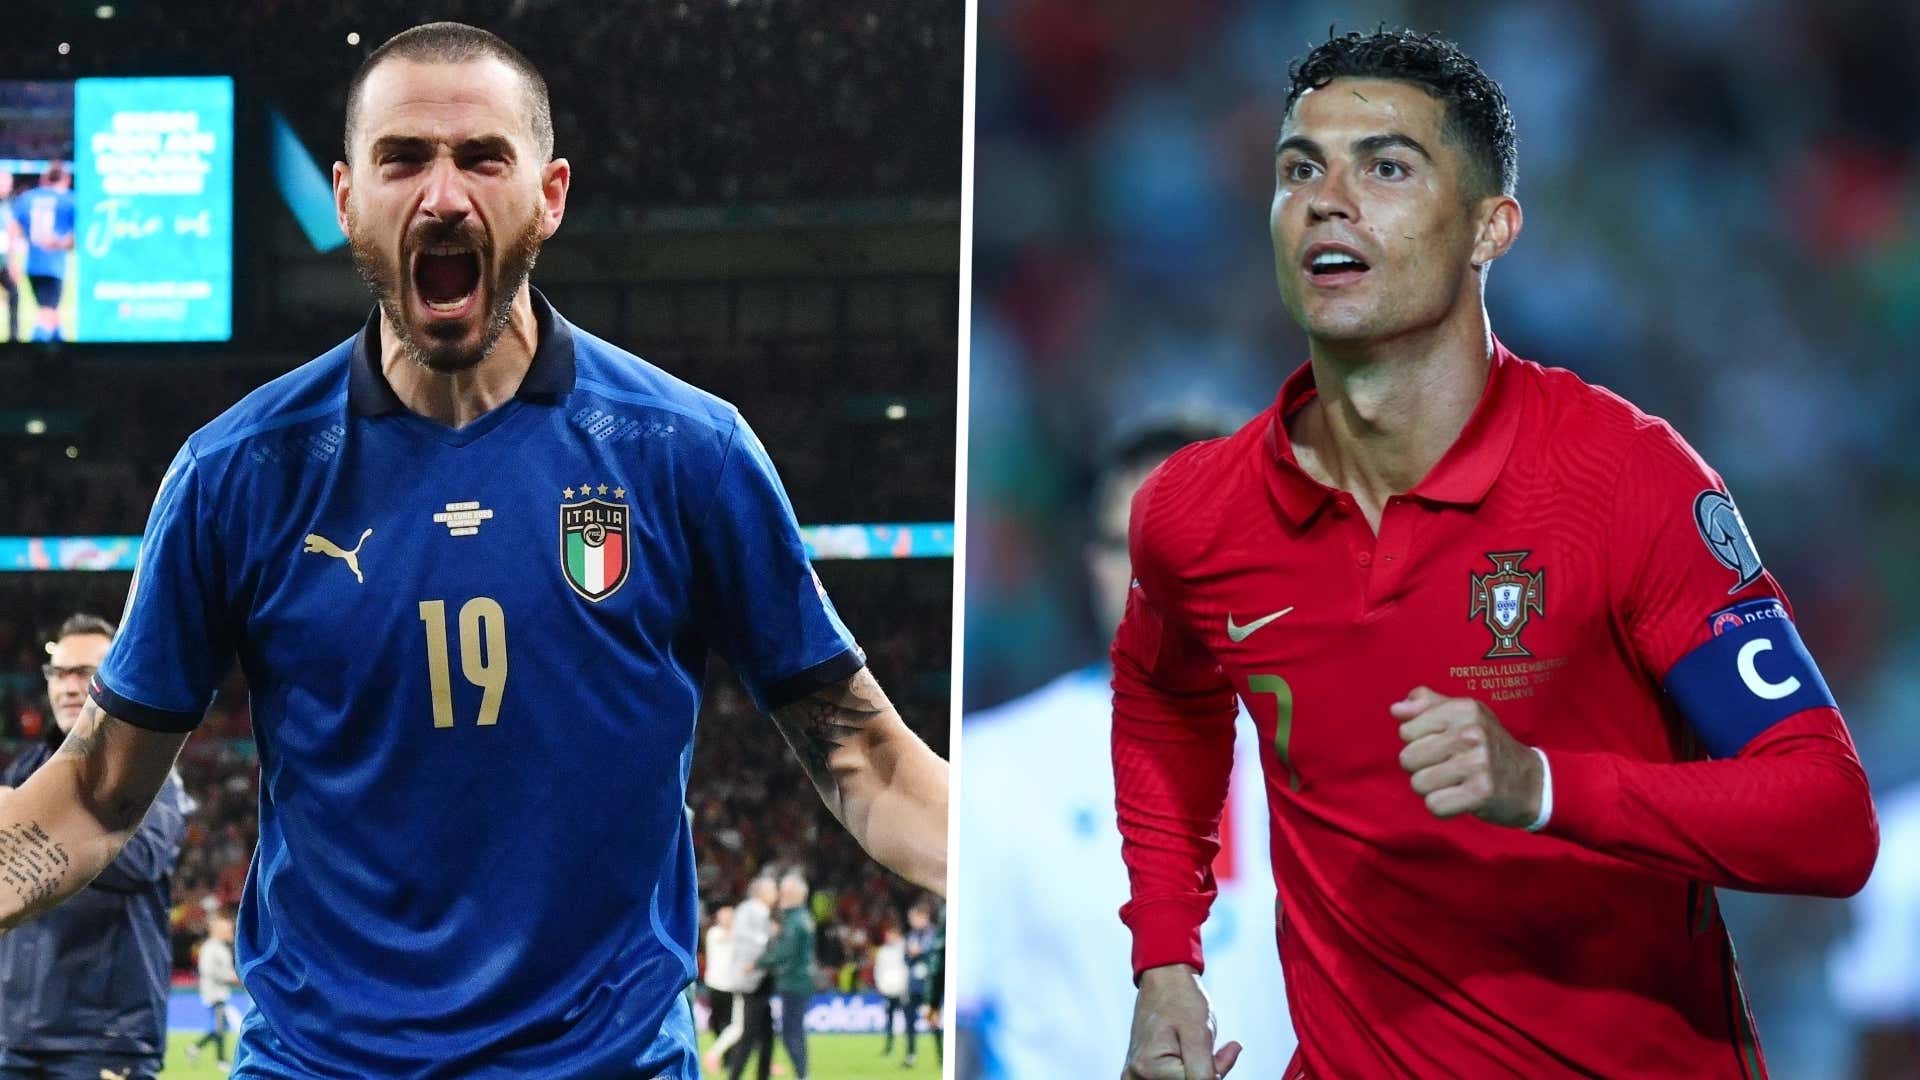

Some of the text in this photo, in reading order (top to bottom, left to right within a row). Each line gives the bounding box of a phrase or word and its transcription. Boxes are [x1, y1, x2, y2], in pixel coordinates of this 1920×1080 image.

[566, 509, 622, 525] ITALIA
[418, 596, 508, 729] 19
[1466, 679, 1477, 690] 12
[1481, 676, 1529, 690] OUTUBRO
[1736, 637, 1801, 700] C
[1247, 673, 1300, 793] 7
